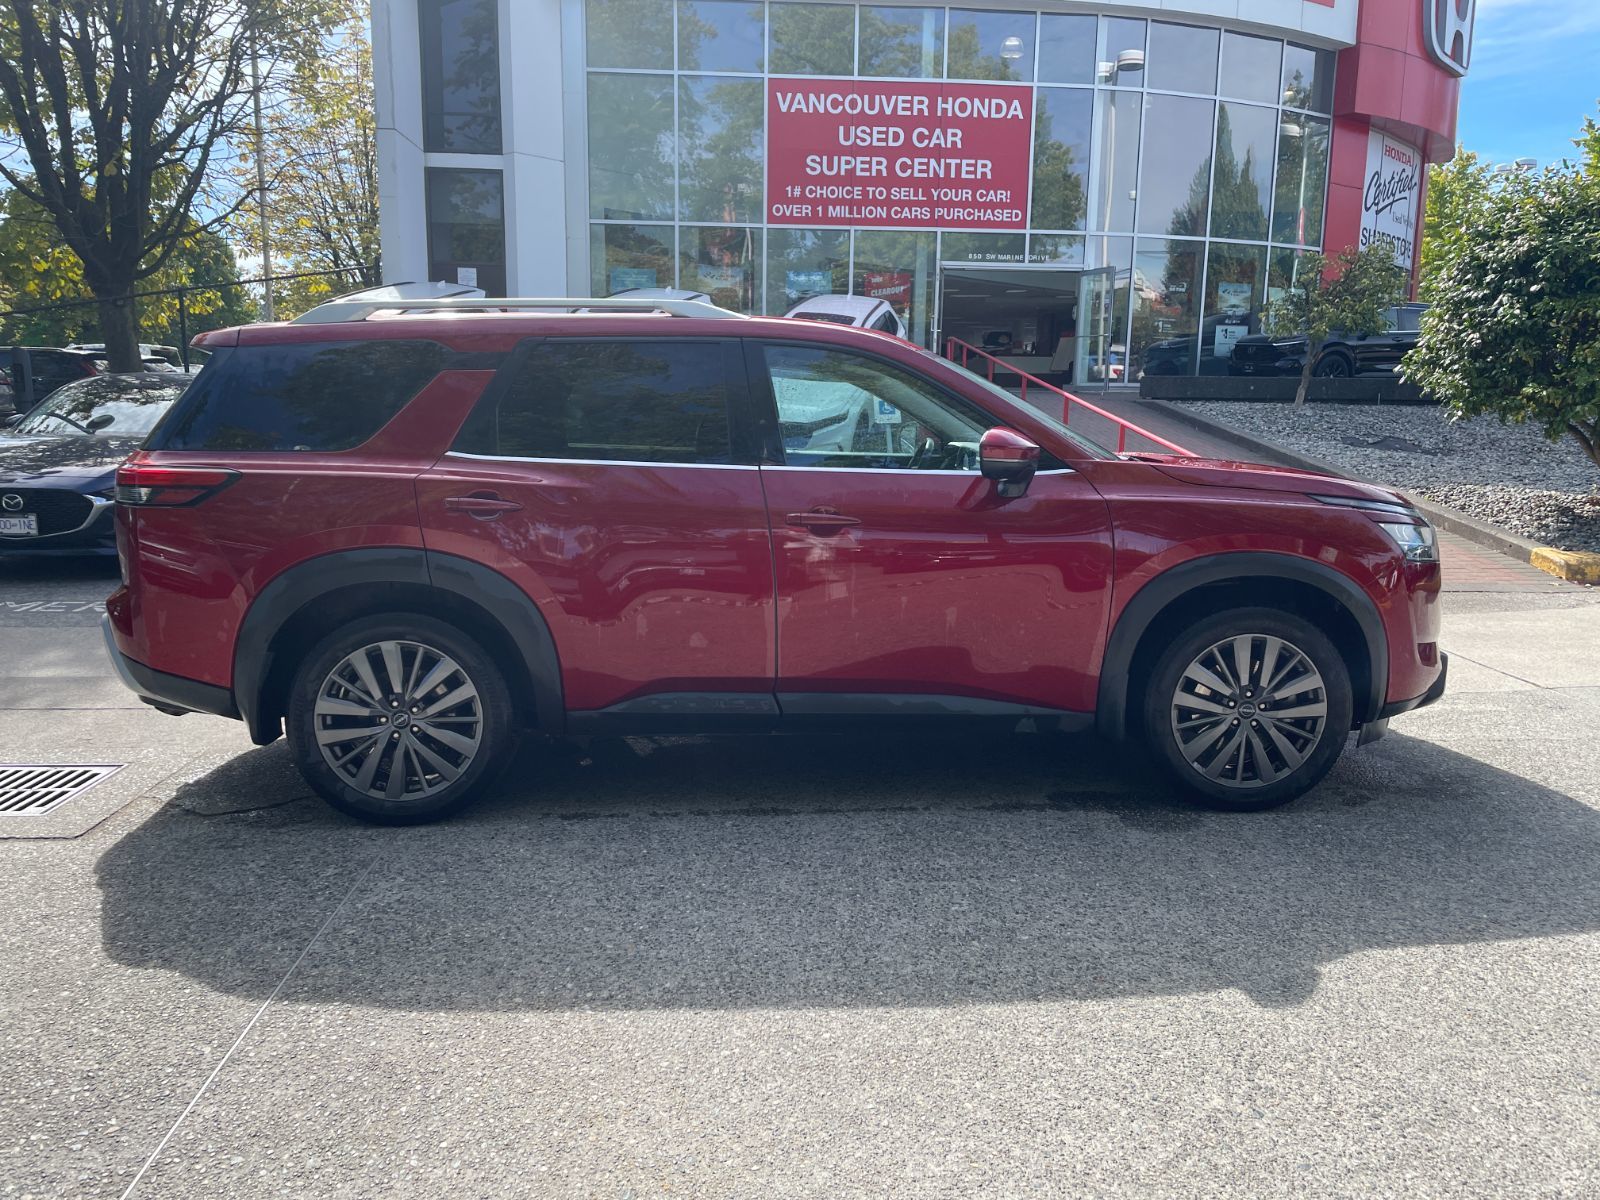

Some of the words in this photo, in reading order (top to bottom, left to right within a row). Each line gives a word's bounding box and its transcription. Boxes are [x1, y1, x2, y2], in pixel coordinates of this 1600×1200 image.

[776, 92, 928, 116] VANCOUVER
[937, 97, 1023, 119] HONDA
[839, 126, 904, 146] USED
[912, 128, 962, 148] CAR
[806, 155, 887, 176] SUPER
[895, 157, 991, 179] CENTER
[1384, 145, 1412, 167] HONDA
[786, 186, 801, 197] 1#
[806, 186, 862, 198] CHOICE
[867, 187, 886, 199] TO
[891, 188, 927, 200] SELL
[931, 189, 971, 201] YOUR
[976, 190, 1010, 202] CAR!
[1364, 164, 1417, 214] Certified
[773, 204, 811, 216] OVER
[817, 206, 822, 216] 1
[829, 206, 886, 218] MILLION
[891, 207, 930, 219] CARS
[935, 208, 1021, 221] PURCHASED
